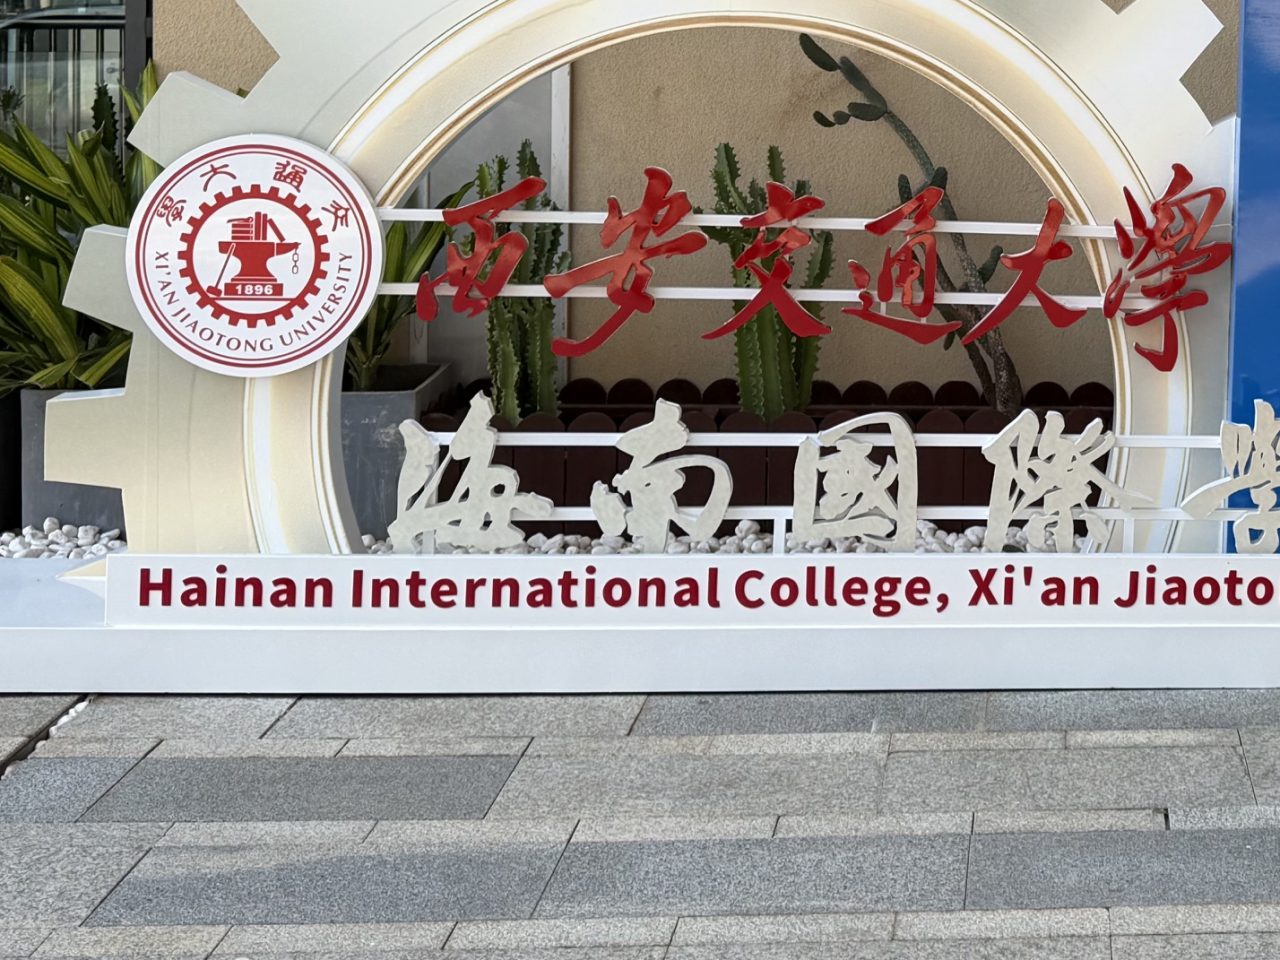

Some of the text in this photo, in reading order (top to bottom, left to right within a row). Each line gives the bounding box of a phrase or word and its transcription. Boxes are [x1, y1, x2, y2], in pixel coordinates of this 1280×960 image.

[154, 250, 353, 353] XI'AN JIAOTONG UNIVERSITY
[235, 284, 273, 295] 1896
[139, 566, 333, 607] Hainan
[352, 566, 719, 608] International
[735, 566, 949, 616] College,
[970, 565, 1099, 606] Xi'an
